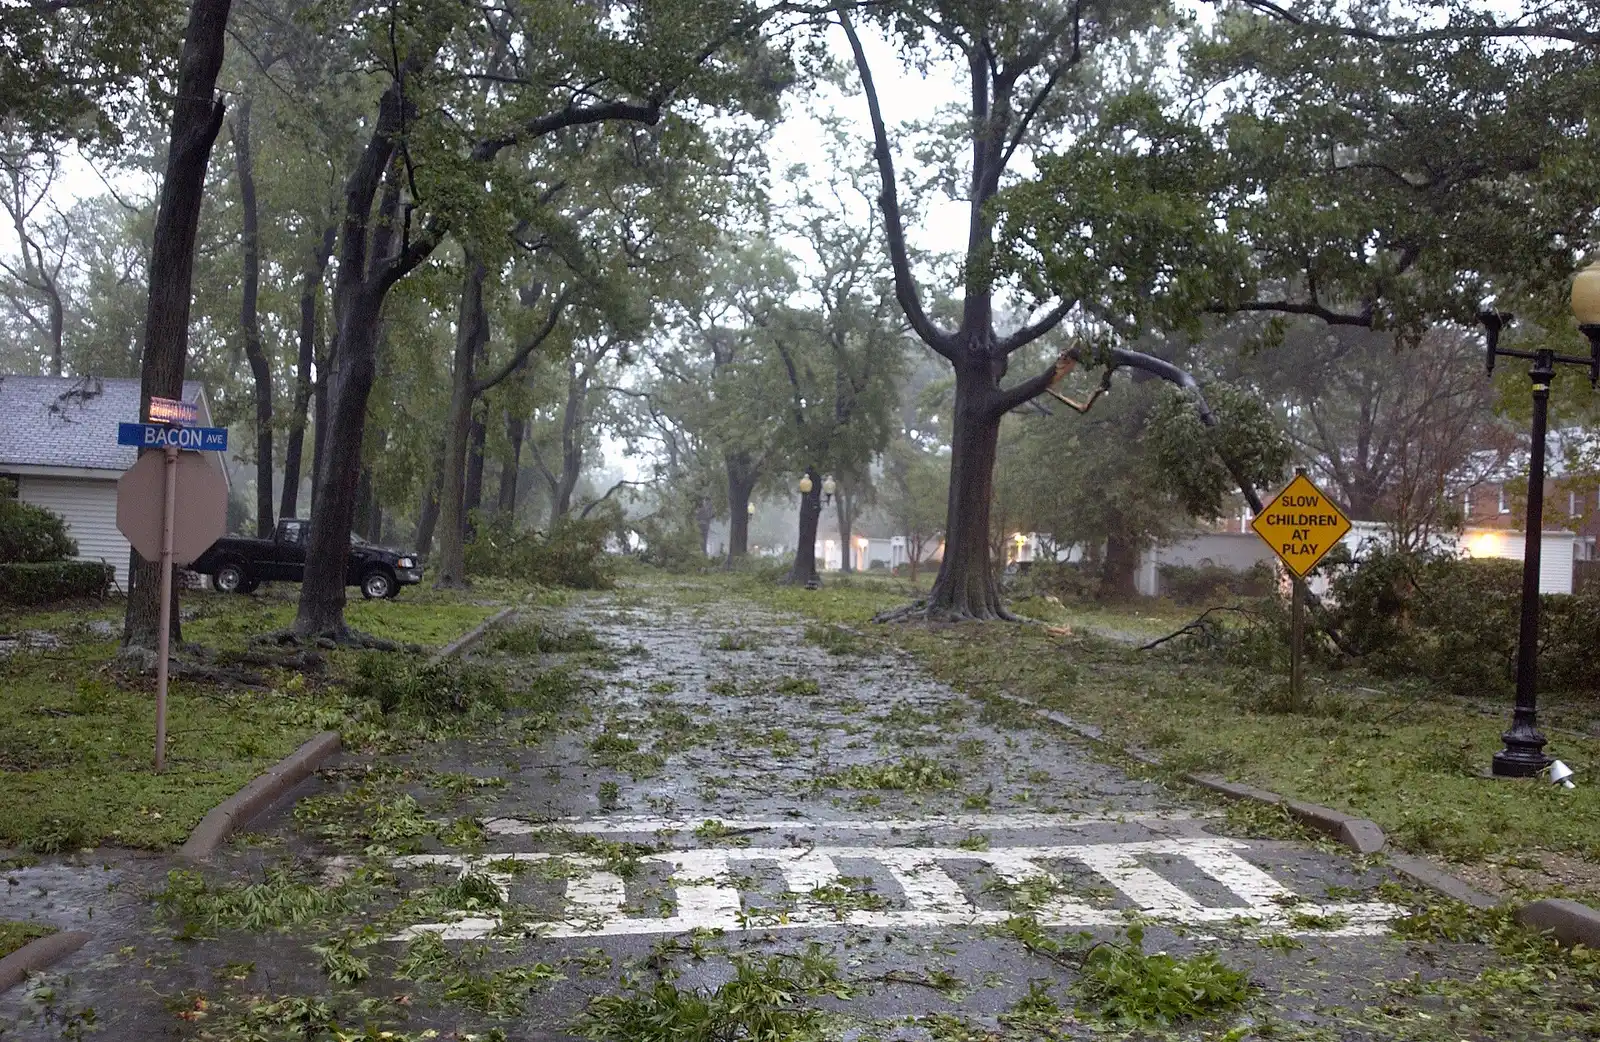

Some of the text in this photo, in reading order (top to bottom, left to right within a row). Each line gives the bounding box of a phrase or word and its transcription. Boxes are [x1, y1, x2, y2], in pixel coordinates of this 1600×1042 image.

[145, 427, 223, 447] BACON AVE
[1282, 495, 1319, 507] SLOW
[1266, 514, 1338, 526] CHILDREN
[1292, 529, 1310, 540] AT
[1282, 543, 1319, 555] PLAY
